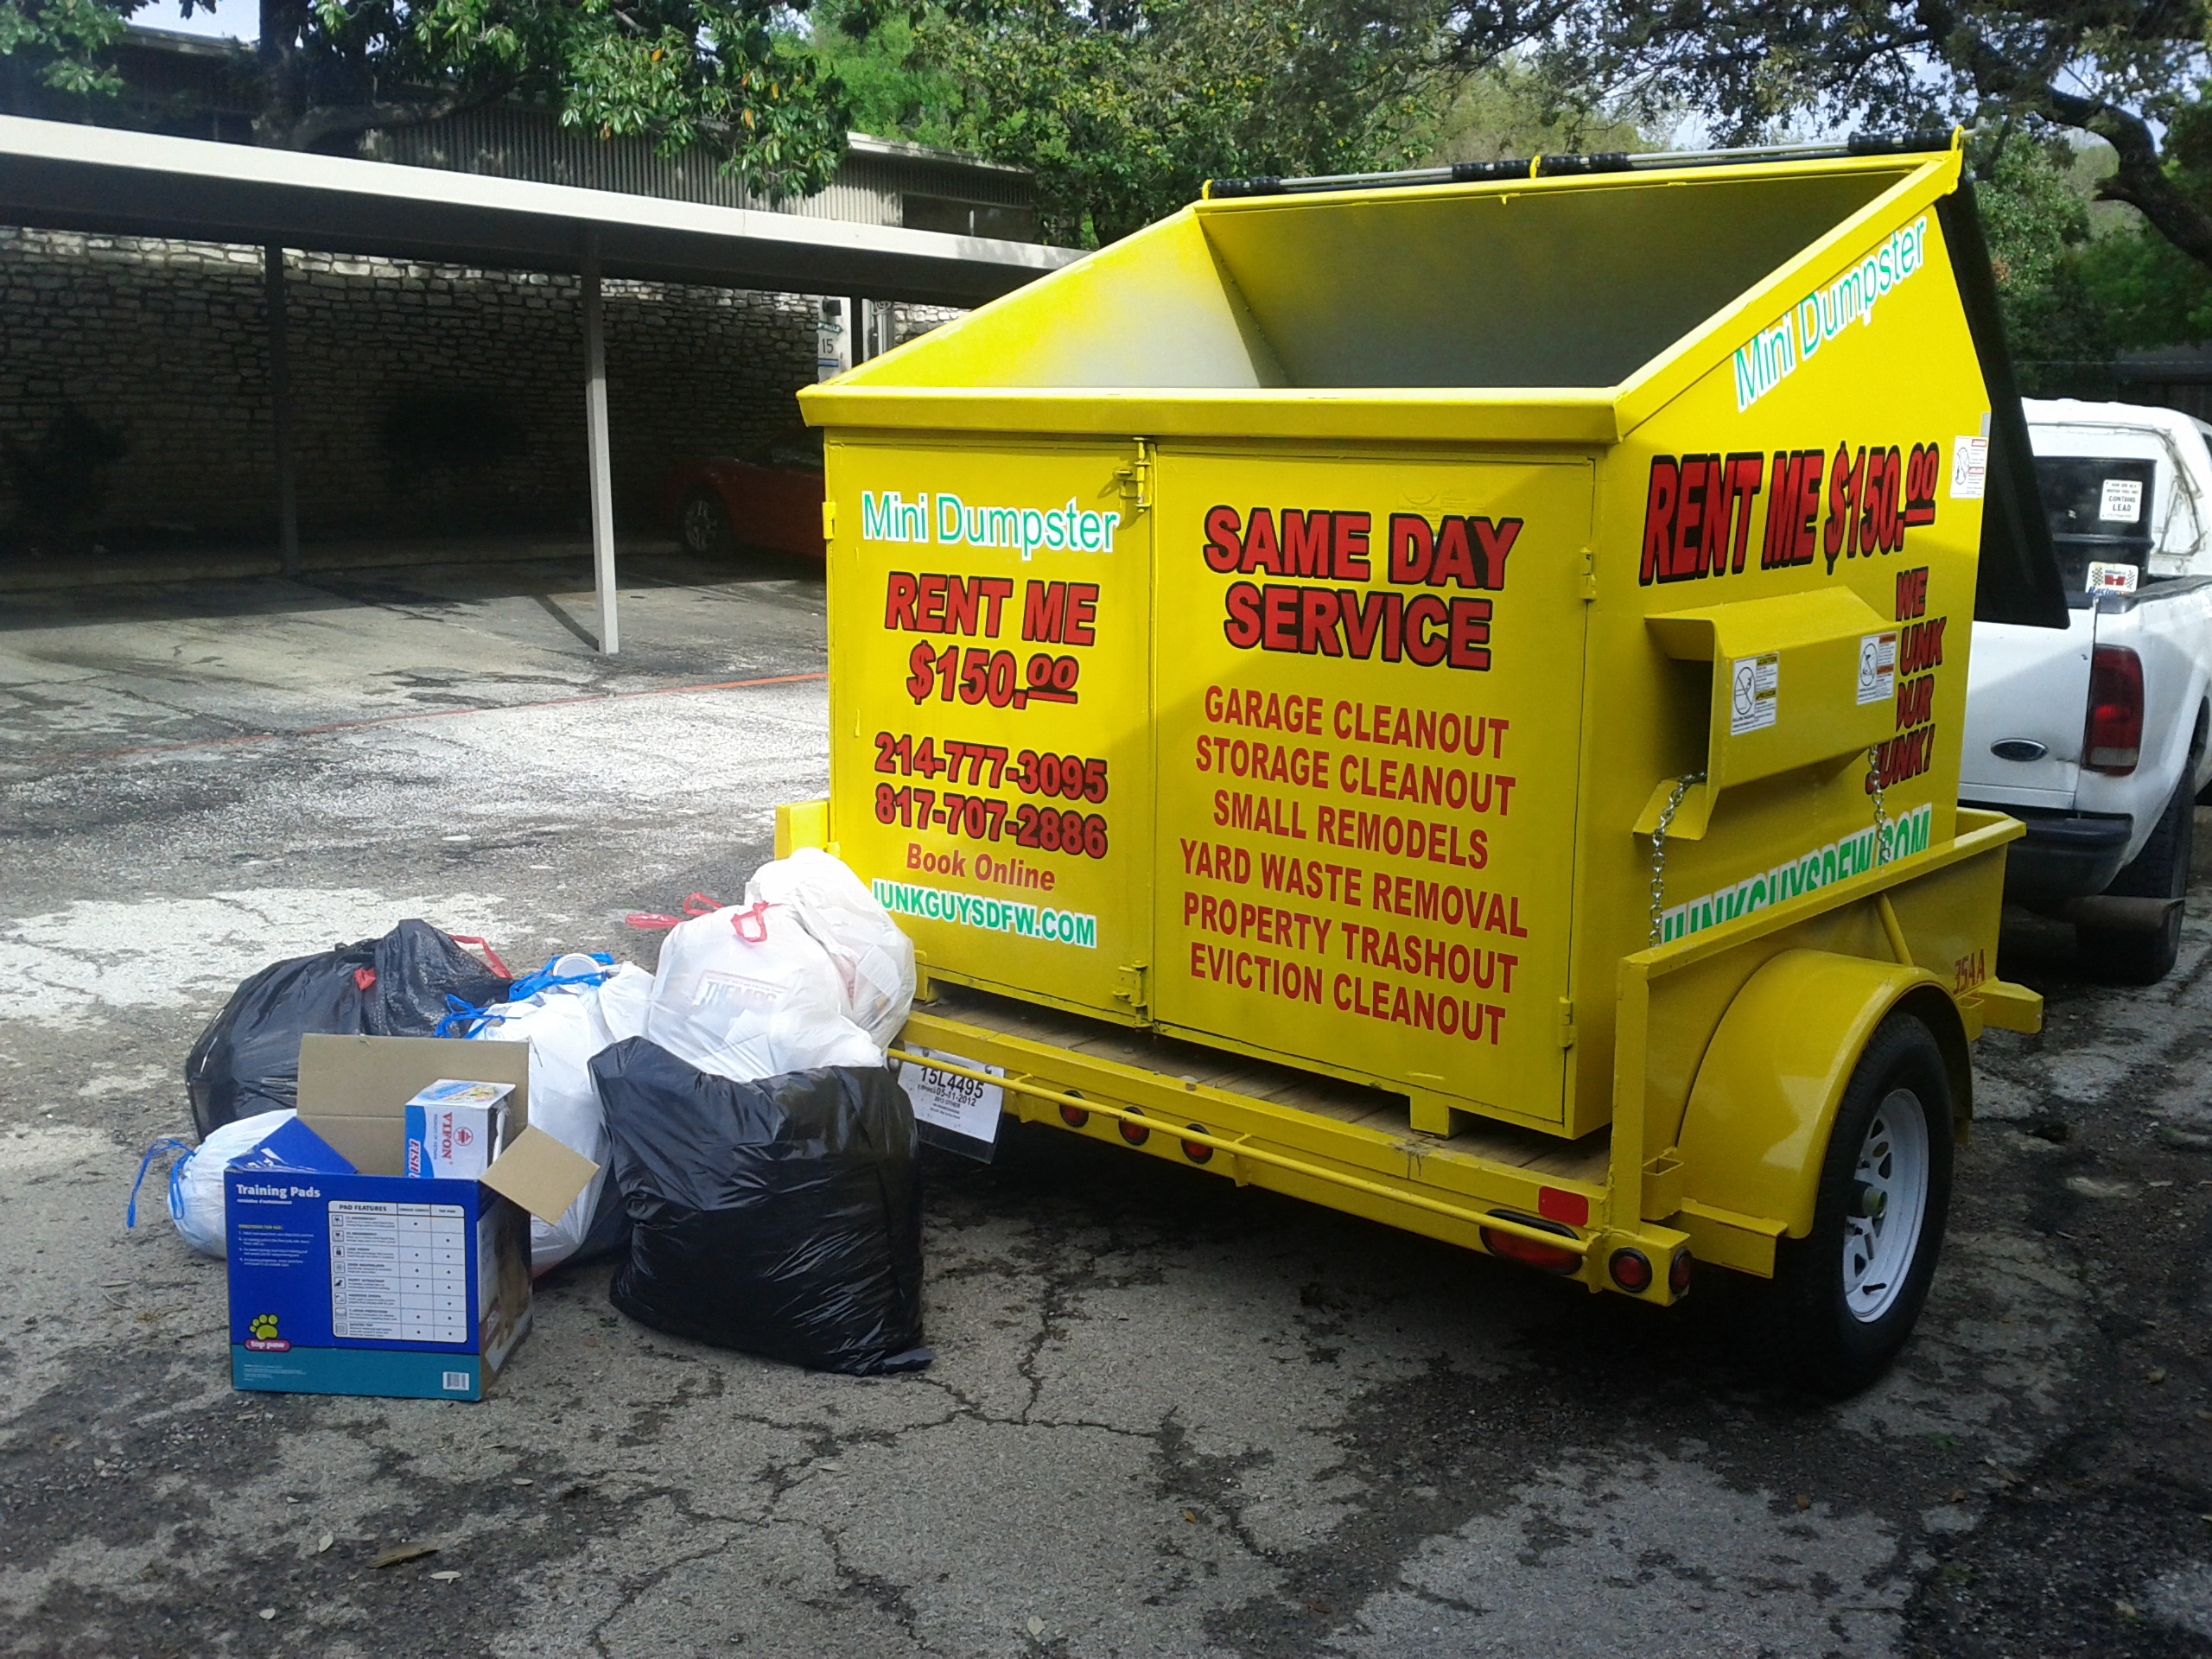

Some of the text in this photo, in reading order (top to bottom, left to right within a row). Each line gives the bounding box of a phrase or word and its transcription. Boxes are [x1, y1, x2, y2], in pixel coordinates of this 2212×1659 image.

[822, 338, 834, 354] 15
[1732, 216, 1927, 413] Mini Dumpster
[862, 491, 1120, 560] Mini Dumpster
[1204, 505, 1524, 590] SAME DAY
[1639, 441, 1938, 587] RENT ME $150.00
[884, 571, 1099, 646] RENT ME
[1224, 582, 1493, 671] SERVICE
[1896, 566, 1929, 622] WE
[906, 640, 1079, 709] $150.00
[1900, 617, 1947, 677] UNK
[1205, 685, 1509, 759] GARAGE CLEANOUT
[874, 731, 1108, 804] 214-777-3095
[1196, 734, 1516, 816] STORAGE CLEANOUT
[874, 782, 1108, 858] 817-707-2886
[1213, 789, 1488, 869] SMALL REMODELS
[906, 842, 1055, 891] Book Online
[1180, 838, 1528, 938] YARD WASTE REMOVAL
[1184, 891, 1518, 994] PROPERTY TRASHOUT
[1191, 942, 1506, 1045] EVICTION CLEANOUT
[920, 1067, 985, 1099] 15L4495
[936, 1087, 976, 1107] 05-11-2012
[409, 1138, 421, 1173] FISH
[442, 1112, 453, 1160] VIFON
[236, 1184, 321, 1199] Training Pads
